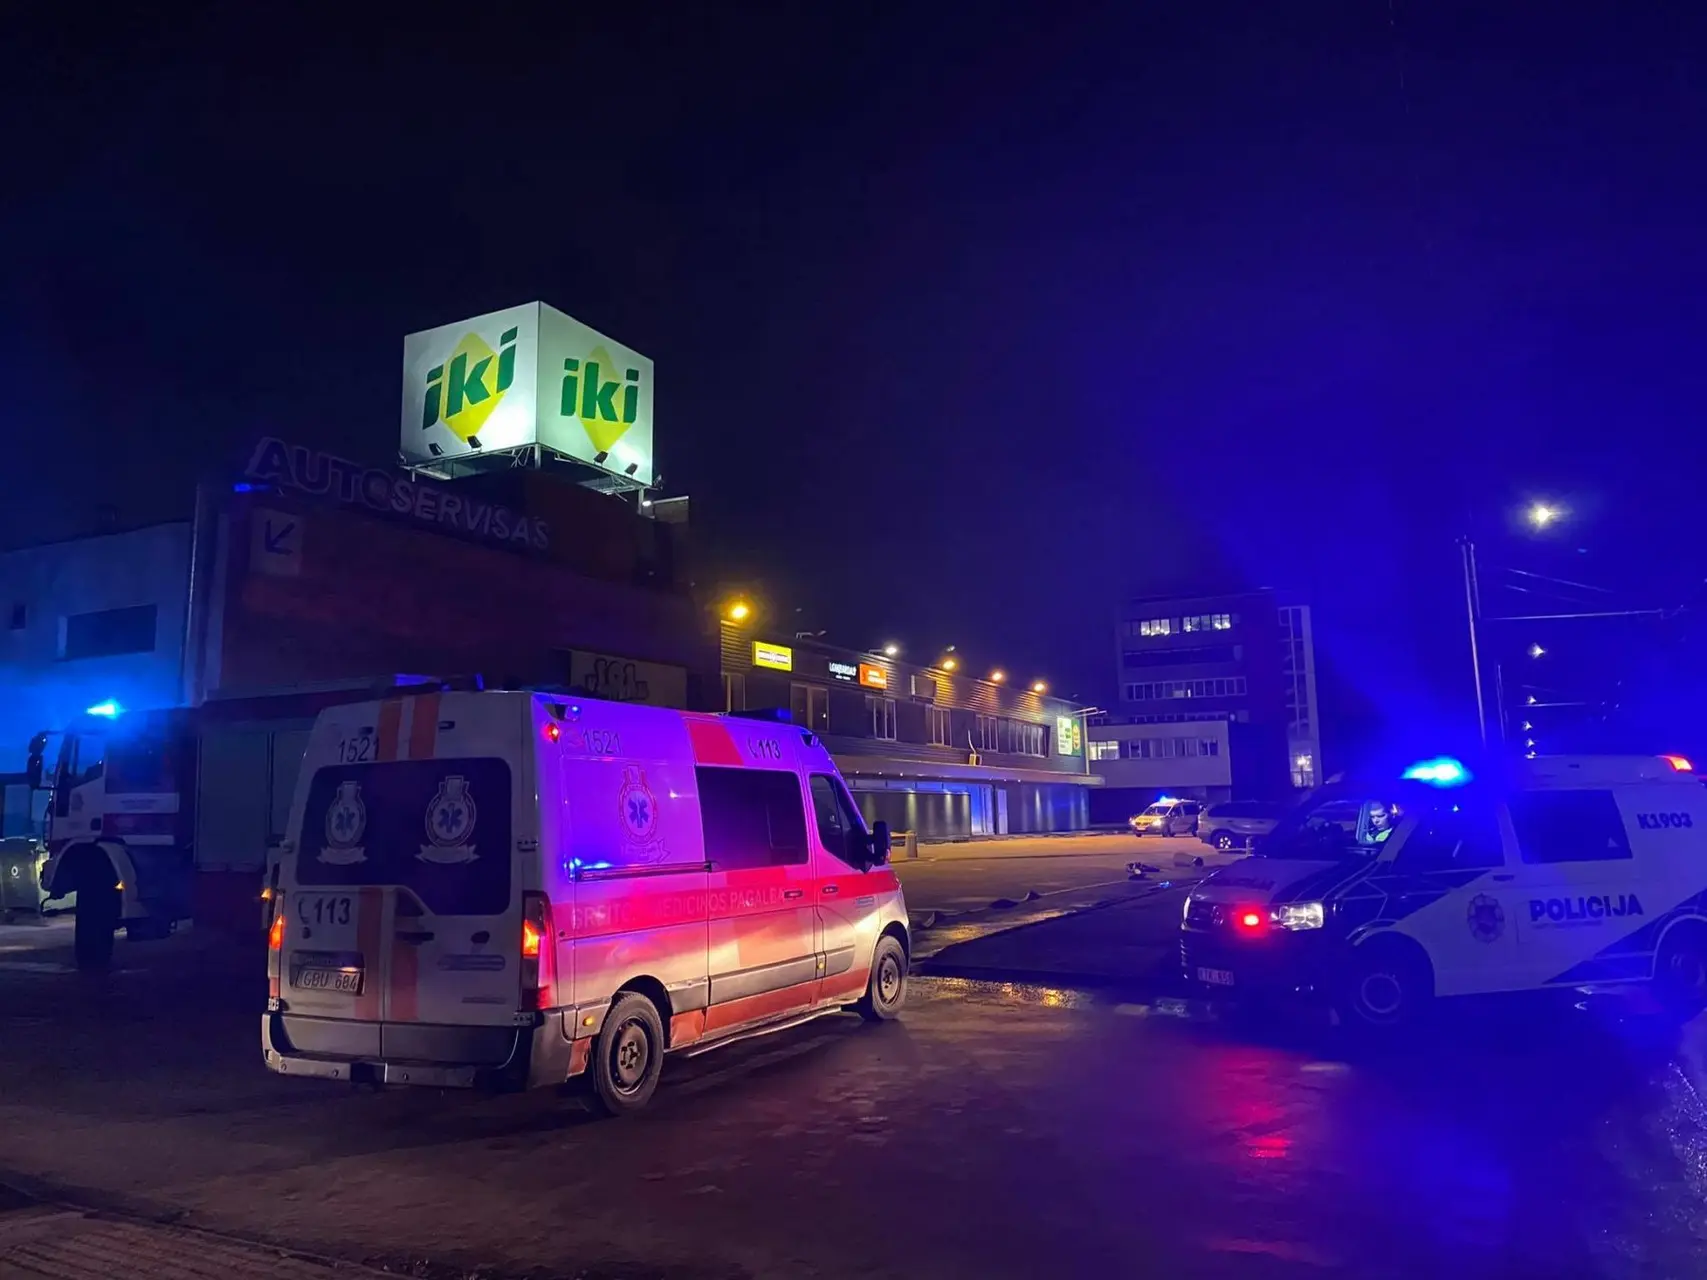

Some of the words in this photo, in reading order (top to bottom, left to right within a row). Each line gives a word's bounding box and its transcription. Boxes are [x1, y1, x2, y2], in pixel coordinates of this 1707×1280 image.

[422, 326, 518, 430] iki
[560, 358, 639, 424] iki
[338, 736, 379, 763] 1521
[583, 729, 622, 755] 1521
[758, 739, 782, 760] 113
[1637, 812, 1693, 829] K1903
[313, 897, 351, 925] 113
[1529, 893, 1644, 922] POLICIJA
